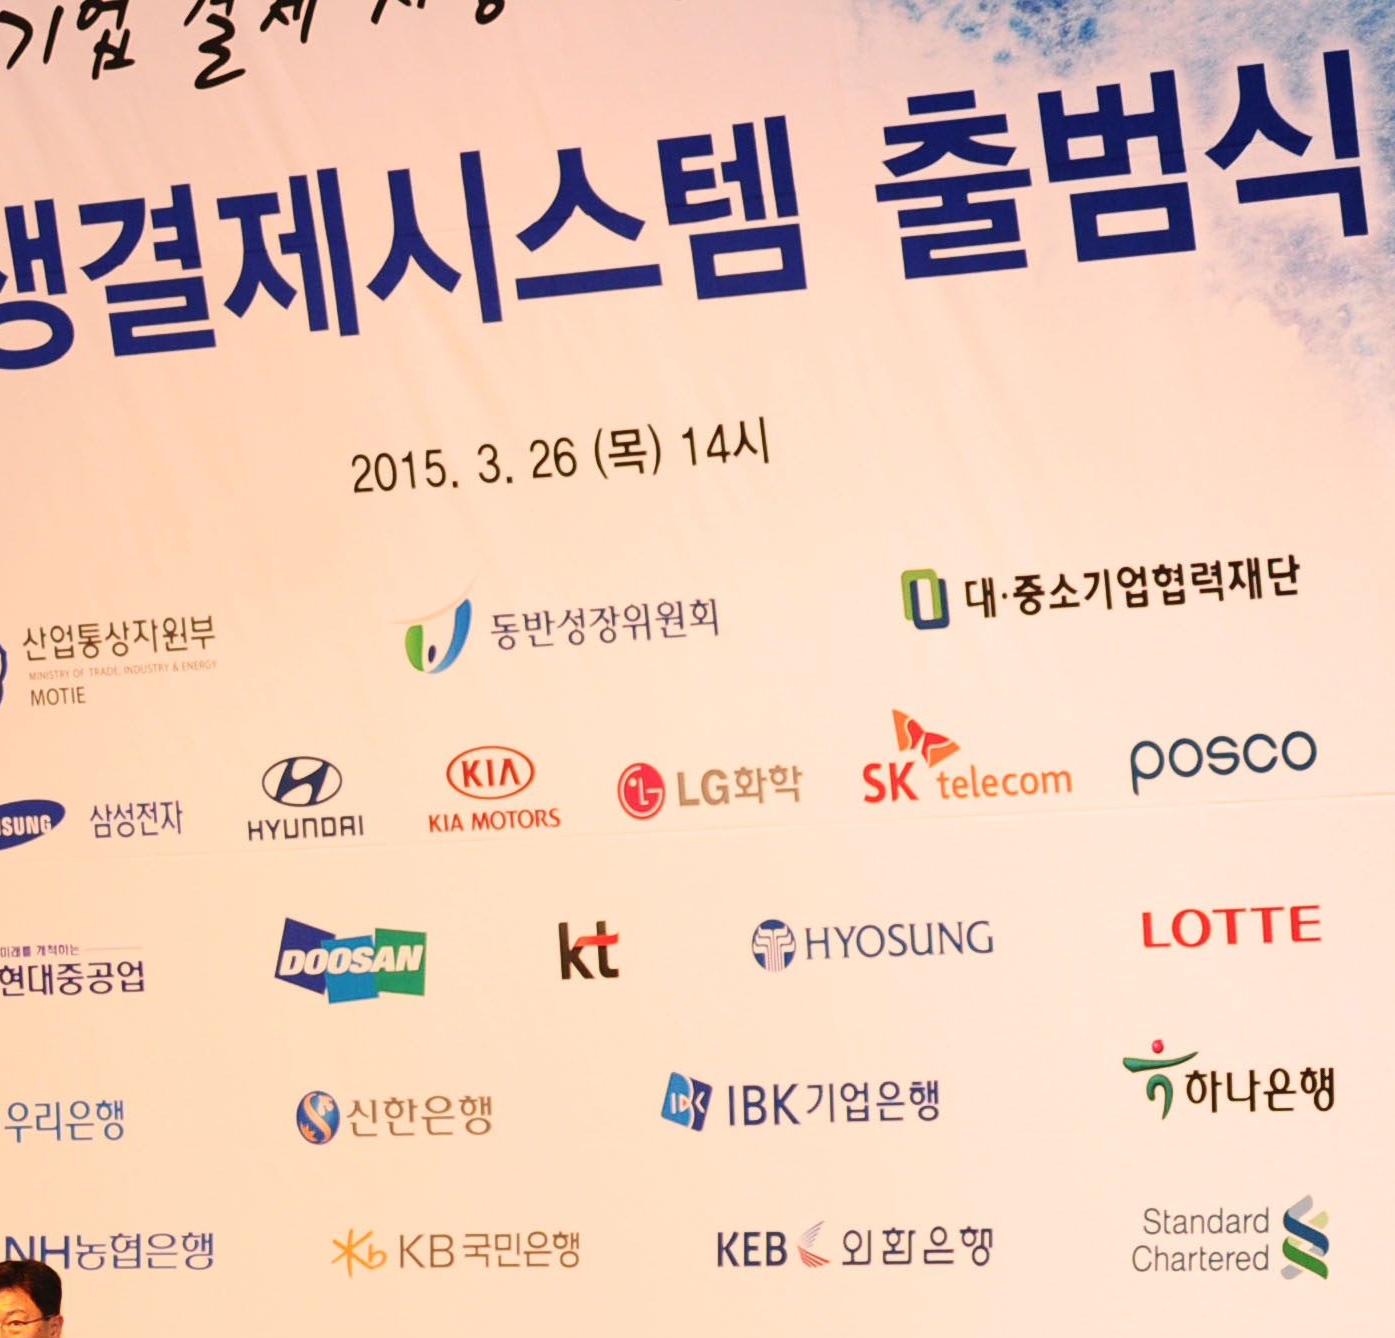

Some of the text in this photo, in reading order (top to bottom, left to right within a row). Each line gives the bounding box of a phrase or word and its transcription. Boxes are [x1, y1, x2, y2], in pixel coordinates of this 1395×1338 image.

[869, 45, 1374, 287] 출범식
[352, 417, 768, 493] 2015. 3. 26 (목) 14시
[21, 613, 217, 662] 산업통상자원부
[491, 599, 718, 650] 동반성장위원회
[29, 669, 69, 680] MINISTRY
[124, 663, 168, 675] INDUSTRY
[182, 660, 217, 671] ENERGY
[31, 687, 85, 706] MOTIE
[461, 758, 515, 788] KIA
[863, 760, 1072, 803] SK telecom
[1130, 731, 1317, 795] posco
[677, 765, 802, 807] LG화학
[90, 801, 182, 838] 삼성전자
[248, 816, 363, 841] HYUNDAI
[429, 808, 560, 832] KIA MOTORS
[806, 921, 993, 959] HYOSUNG
[1142, 905, 1321, 948] LOTTE
[279, 945, 423, 977] DOOSAN
[559, 921, 619, 979] kt
[1186, 1067, 1334, 1113] 하나은행
[5, 1100, 124, 1143] 우리은행
[347, 1096, 491, 1137] 신한은행
[1144, 1207, 1269, 1235] Standard
[718, 1232, 787, 1267] KEB
[842, 1226, 992, 1266] 외환은행
[1132, 1244, 1269, 1272] Chartered
